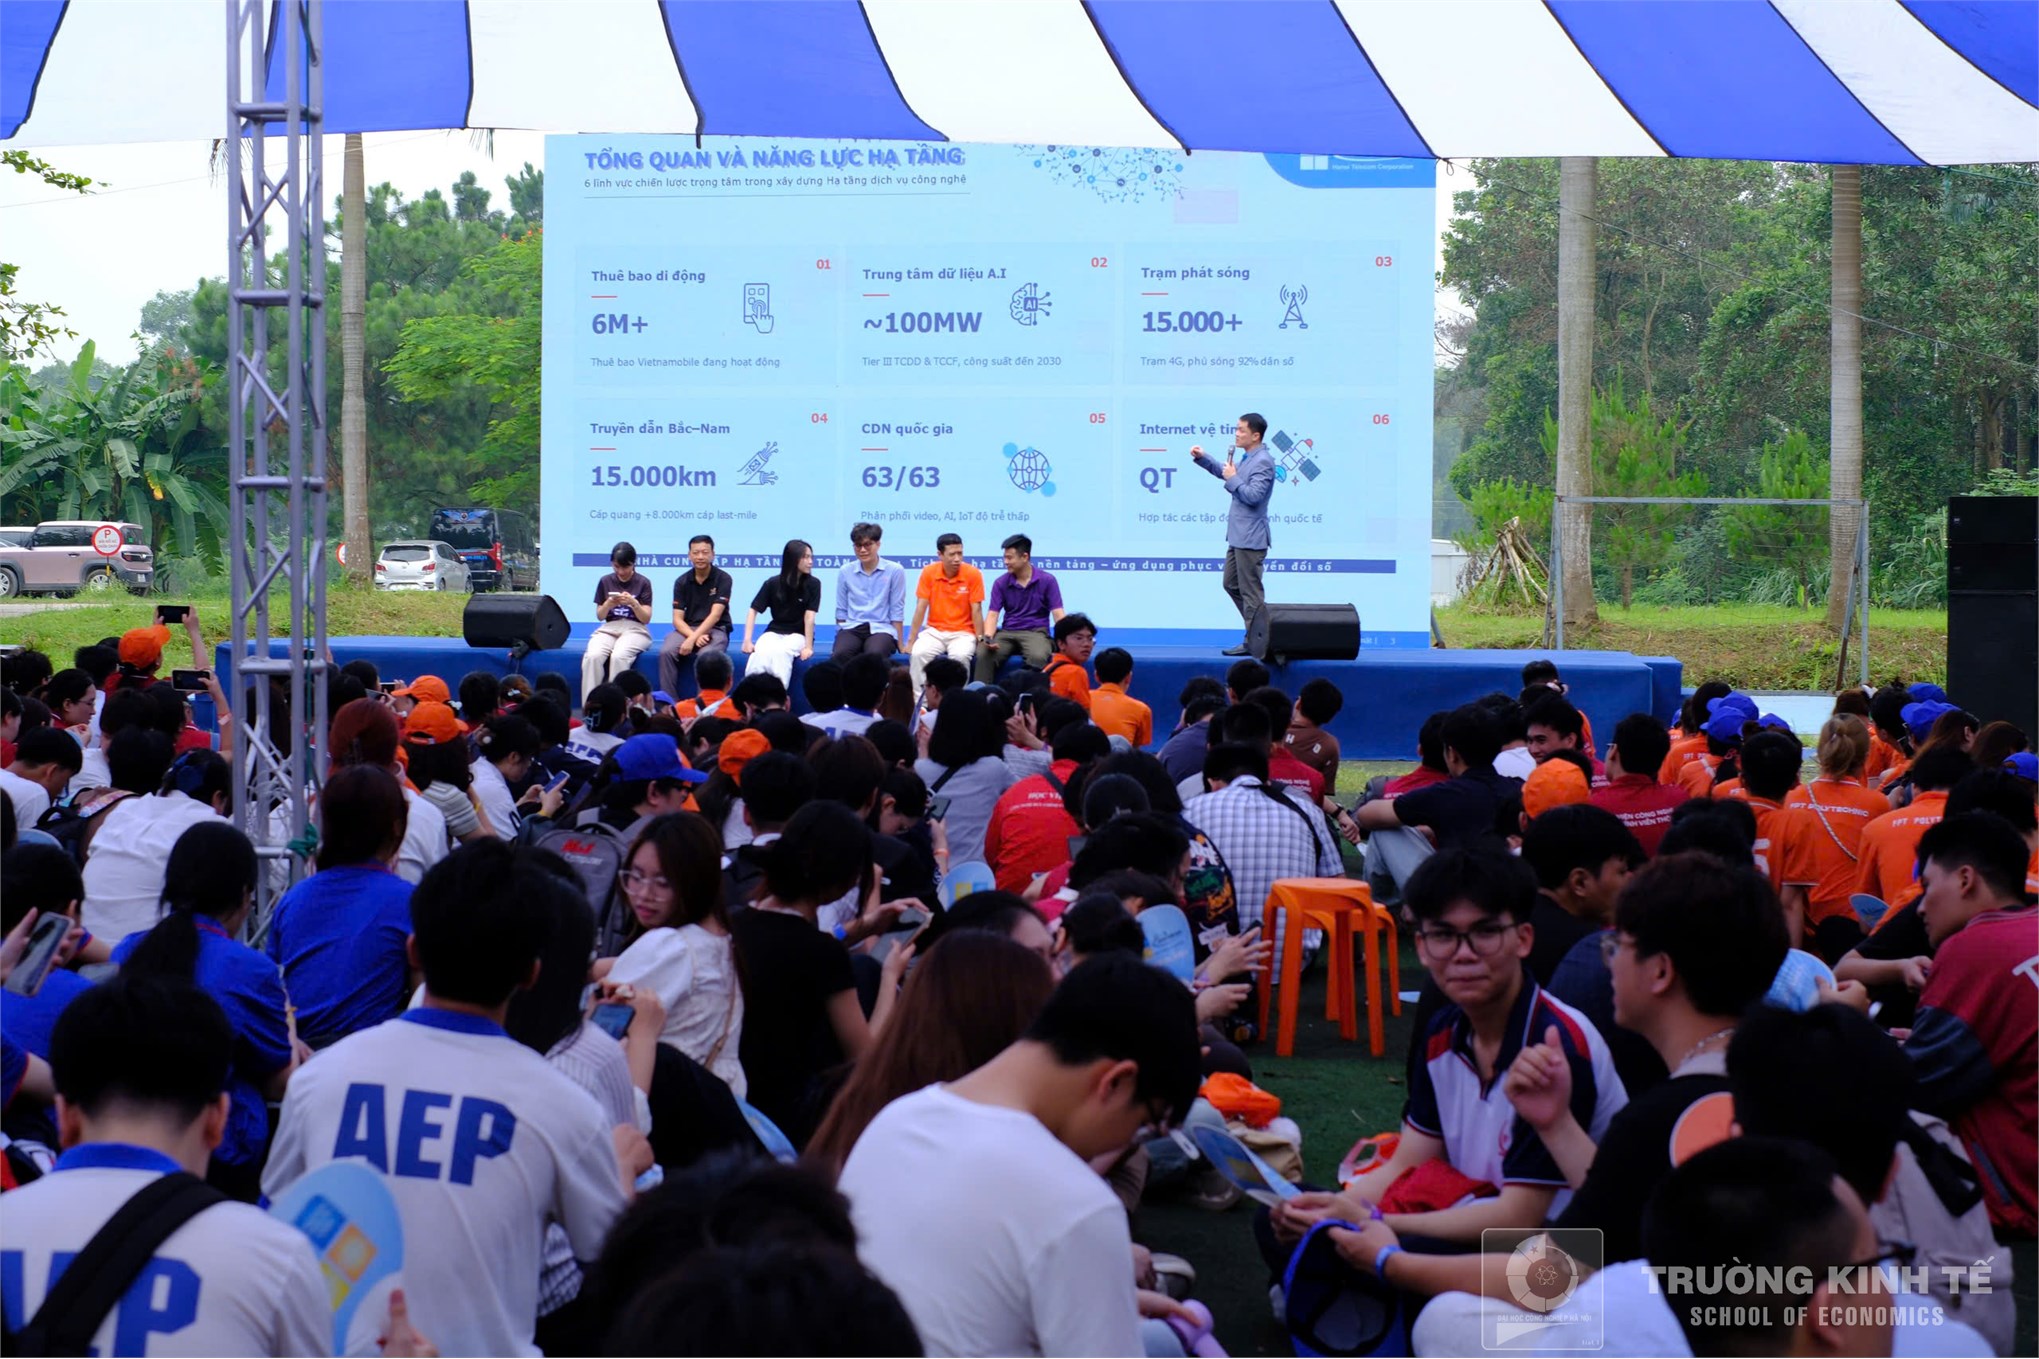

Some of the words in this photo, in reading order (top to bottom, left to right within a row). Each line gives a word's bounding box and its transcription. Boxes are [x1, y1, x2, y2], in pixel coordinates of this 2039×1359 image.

[585, 147, 644, 170] TỔNG
[649, 151, 711, 172] QUAN
[717, 145, 748, 169] VÀ
[753, 145, 815, 168] NĂNG
[820, 147, 863, 171] LỰC
[868, 149, 901, 171] HẠ
[904, 143, 966, 167] TẦNG
[584, 178, 591, 188] 6
[593, 178, 612, 188] lĩnh
[615, 179, 632, 189] vực
[635, 178, 663, 188] chiến
[666, 178, 687, 187] lược
[690, 178, 718, 189] trọng
[721, 177, 741, 187] tâm
[745, 178, 773, 188] trong
[776, 177, 793, 187] xây
[796, 176, 823, 188] dựng
[827, 176, 840, 186] Hạ
[843, 175, 867, 187] tầng
[871, 175, 892, 187] dịch
[896, 177, 908, 186] vụ
[911, 175, 937, 185] công
[940, 174, 967, 186] nghệ
[816, 259, 831, 270] 01
[1091, 257, 1108, 268] 02
[1375, 256, 1392, 267] 03
[591, 269, 624, 282] Thuê
[628, 270, 651, 282] bao
[656, 270, 668, 281] di
[672, 269, 706, 284] động
[863, 268, 902, 282] Trung
[907, 268, 933, 280] tâm
[938, 268, 957, 280] dữ
[959, 267, 983, 282] liệu
[987, 268, 1007, 279] A.I
[1141, 267, 1177, 281] Trạm
[1181, 266, 1213, 281] phát
[1217, 266, 1250, 281] sóng
[1024, 299, 1037, 310] AI
[592, 314, 648, 334] 6M+
[864, 312, 983, 333] ~100MW
[1142, 311, 1243, 332] 15.000+
[591, 357, 615, 368] Thuê
[618, 357, 634, 367] bao
[638, 357, 700, 367] Vietnamobile
[703, 357, 727, 369] đang
[731, 357, 752, 369] hoạt
[755, 356, 780, 369] động
[862, 357, 880, 367] Tier
[883, 357, 892, 367] III
[894, 357, 921, 367] TCDD
[923, 357, 931, 367] &
[963, 356, 988, 368] công
[991, 356, 1012, 367] suất
[1015, 356, 1034, 367] đến
[1037, 356, 1062, 367] 2030
[1140, 356, 1167, 368] Trạm
[1168, 356, 1185, 368] 4G,
[1187, 356, 1207, 368] phủ
[1210, 356, 1235, 368] sóng
[1238, 356, 1259, 367] 92%
[1260, 356, 1279, 367] dân
[1282, 356, 1294, 366] số
[811, 413, 828, 424] 04
[1089, 413, 1106, 424] 05
[1372, 414, 1390, 425] 06
[590, 422, 634, 436] Truyền
[638, 420, 663, 434] dẫn
[861, 423, 891, 434] CDN
[895, 421, 929, 436] quốc
[933, 423, 953, 436] gia
[1140, 423, 1196, 435] Internet
[1200, 423, 1216, 437] vệ
[1220, 424, 1237, 435] tin
[591, 465, 716, 487] 15.000km
[862, 466, 941, 491] 63/63
[1140, 467, 1177, 493] QT
[610, 510, 641, 521] quang
[645, 510, 695, 519] +8.000km
[717, 510, 757, 520] last-mile
[861, 511, 886, 521] Phân
[889, 510, 910, 522] phối
[914, 511, 941, 521] video,
[959, 511, 973, 521] IoT
[976, 510, 988, 522] độ
[990, 510, 1005, 521] trễ
[1007, 510, 1030, 522] thấp
[1139, 512, 1159, 524] Hợp
[1163, 512, 1178, 523] tác
[1181, 512, 1197, 523] các
[1200, 513, 1216, 524] tập
[1284, 513, 1309, 525] quốc
[1312, 513, 1323, 524] tế
[104, 529, 112, 538] P
[664, 557, 689, 566] CUN
[734, 557, 750, 568] HẠ
[756, 555, 780, 566] TẦN
[971, 559, 986, 570] hạ
[1037, 559, 1060, 568] nền
[1066, 560, 1095, 570] tảng
[1112, 560, 1136, 571] ứng
[1142, 560, 1174, 571] dụng
[1180, 561, 1211, 571] phục
[1291, 560, 1312, 571] đổi
[1317, 561, 1332, 571] số
[1656, 807, 1674, 815] NGH
[1913, 815, 1942, 826] POLYT
[333, 1083, 517, 1186] AEP
